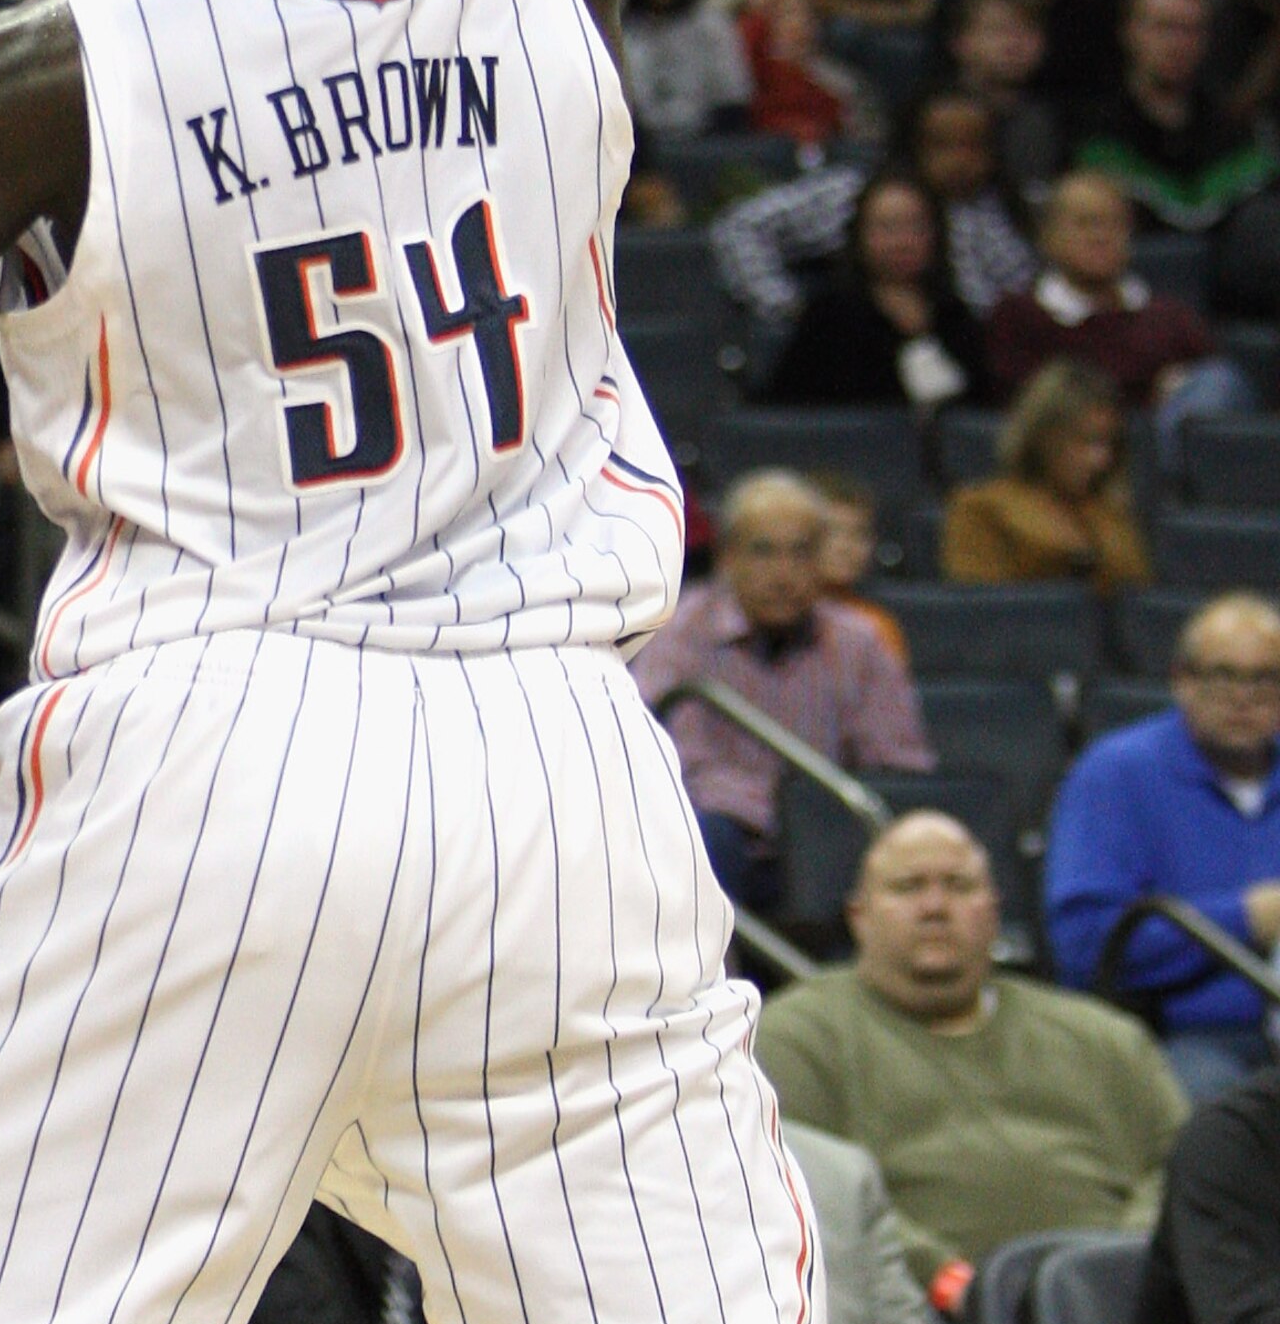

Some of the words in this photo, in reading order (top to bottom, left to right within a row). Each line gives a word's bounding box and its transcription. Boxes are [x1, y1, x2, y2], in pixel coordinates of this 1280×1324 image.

[186, 106, 271, 207] K.
[265, 55, 500, 180] BROWN
[250, 197, 531, 490] 54
